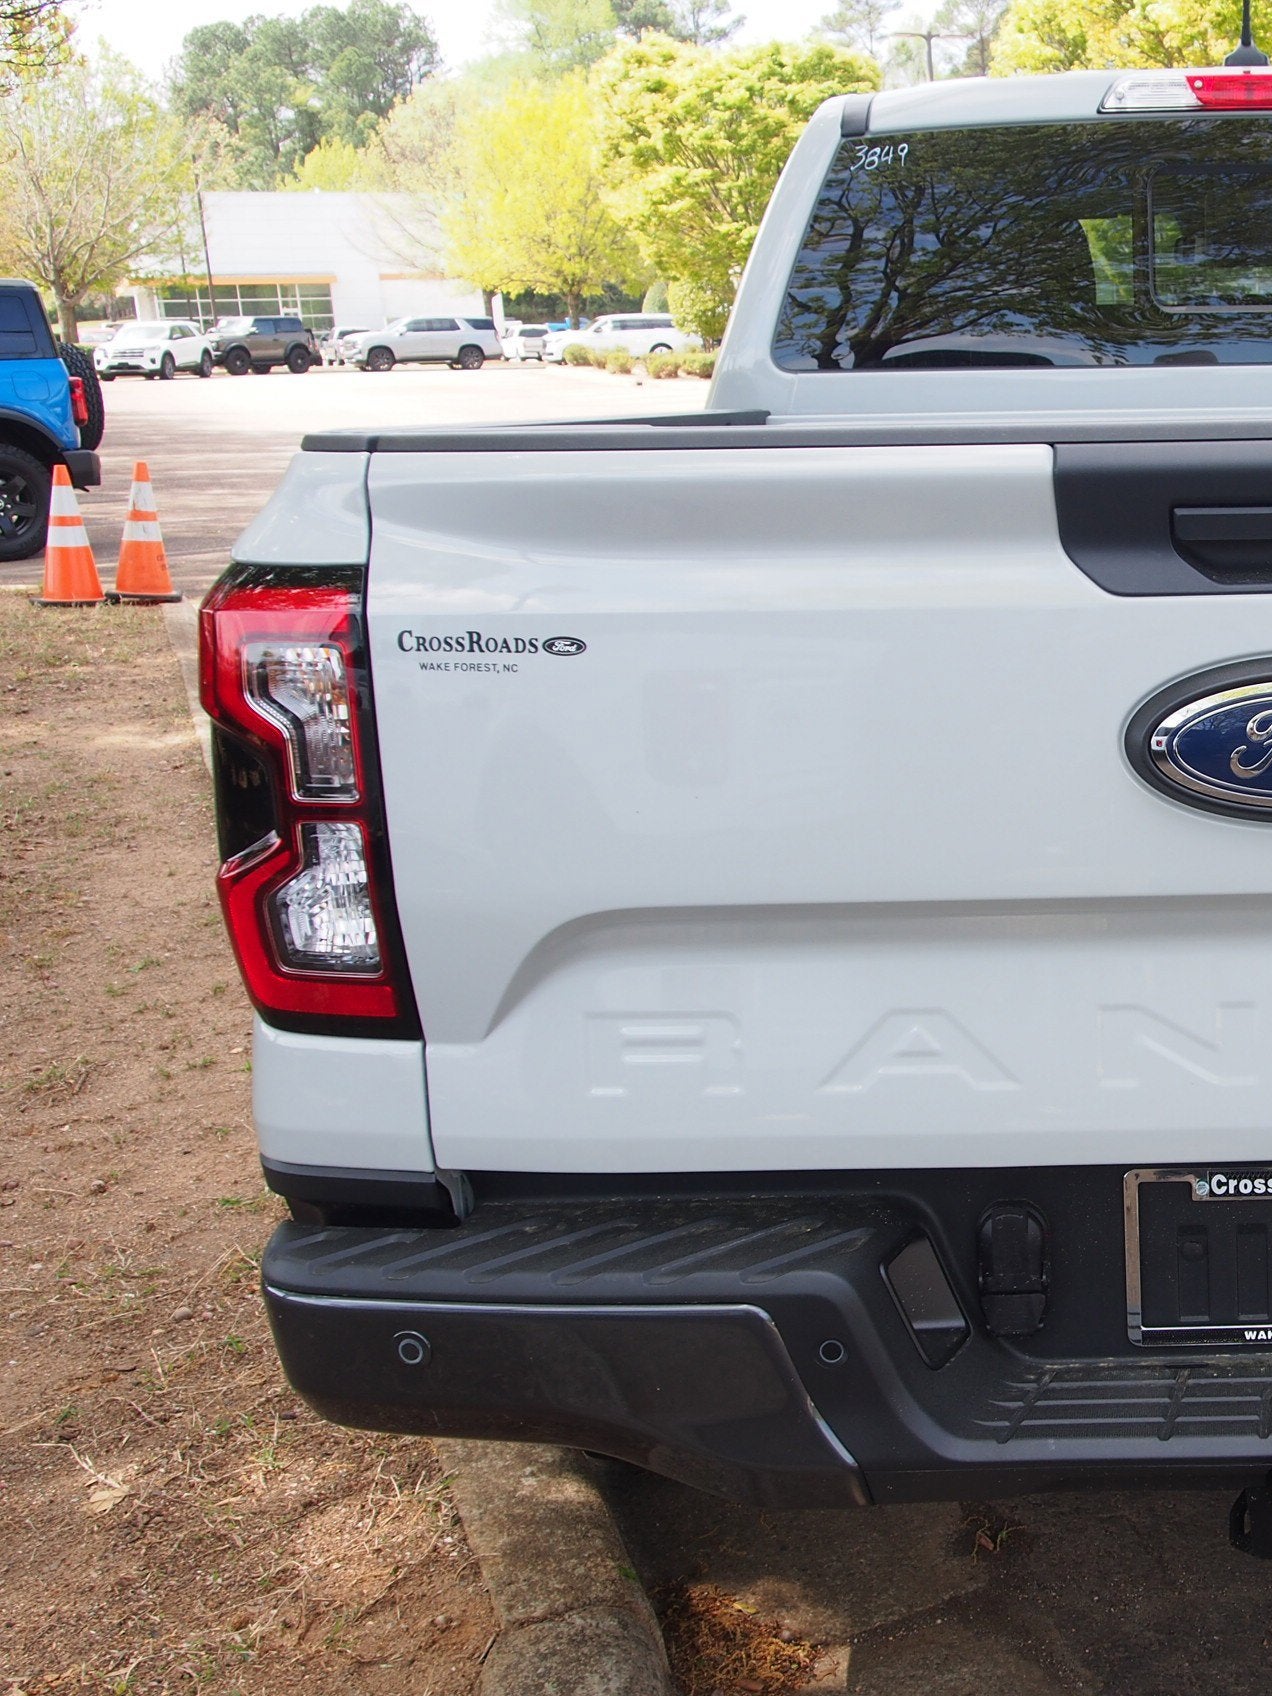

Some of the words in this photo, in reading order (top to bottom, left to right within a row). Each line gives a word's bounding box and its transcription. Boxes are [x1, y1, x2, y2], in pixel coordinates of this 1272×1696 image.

[850, 143, 909, 170] 3849
[419, 662, 450, 672] WAKE
[454, 663, 501, 674] FOREST,
[503, 663, 519, 673] NC
